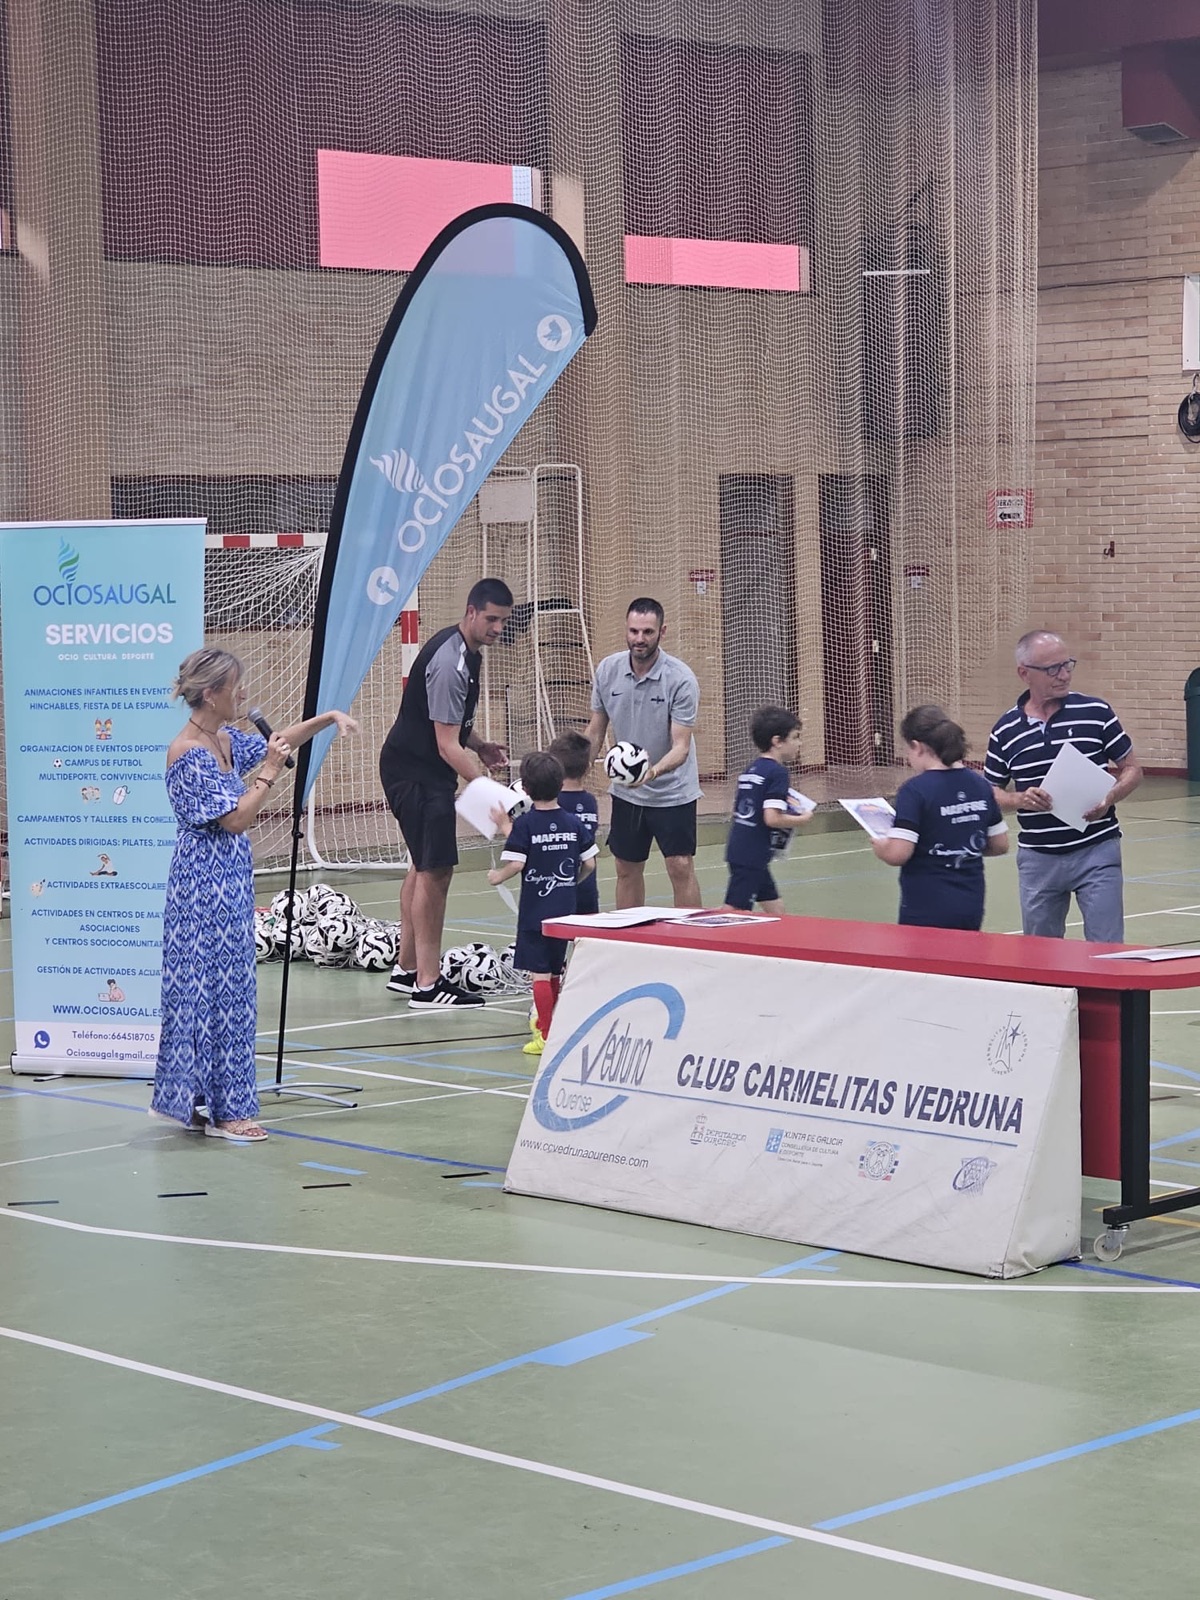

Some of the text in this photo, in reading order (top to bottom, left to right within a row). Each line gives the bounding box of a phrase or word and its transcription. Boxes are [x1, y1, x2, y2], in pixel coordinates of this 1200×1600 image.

[397, 353, 548, 553] OCIOSAUGAL
[33, 583, 177, 606] OCIOSAUGAL
[45, 622, 174, 646] SERVICIOS
[57, 652, 155, 661] OCIO CULTURA DEPORTE
[24, 687, 174, 697] ANIMACIONES INFANTILES EN EVENTO
[29, 702, 82, 711] HINCHABLES,
[83, 702, 110, 710] FIESTA
[111, 702, 122, 710] DE
[123, 702, 134, 710] LA
[19, 744, 83, 753] ORGANIZACION
[84, 744, 95, 753] DE
[96, 744, 133, 753] EVENTOS
[64, 758, 143, 767] CAMPUS DE FUTBOL
[38, 773, 99, 781] MULTIDEPORTE,
[17, 815, 82, 823] CAMPAMENTOS
[83, 815, 89, 823] Y
[90, 815, 128, 824] TALLERES
[24, 837, 78, 846] ACTIVIDADES
[78, 838, 121, 846] DIRIGIDAS:
[122, 838, 155, 847] PILATES,
[531, 832, 578, 844] MAPFRE
[46, 881, 99, 889] ACTIVIDADES
[31, 909, 84, 918] ACTIVIDADES
[85, 910, 95, 918] EN
[96, 910, 133, 919] CENTROS
[135, 911, 145, 919] DE
[79, 924, 141, 933] ASOCIACIONES
[44, 937, 50, 945] Y
[51, 937, 89, 946] CENTROS
[36, 964, 70, 974] GESTIÓN
[72, 966, 83, 975] DE
[84, 967, 137, 976] ACTIVIDADES
[72, 1030, 155, 1042] Teléfono:664518705
[580, 1017, 654, 1087] Vedruna
[676, 1053, 1024, 1134] CLUB CARMELITAS VEDRUNA
[555, 1087, 592, 1113] Ourense
[816, 1136, 844, 1147] GALICIA
[519, 1138, 649, 1169] www.ccvedrunaourense.com
